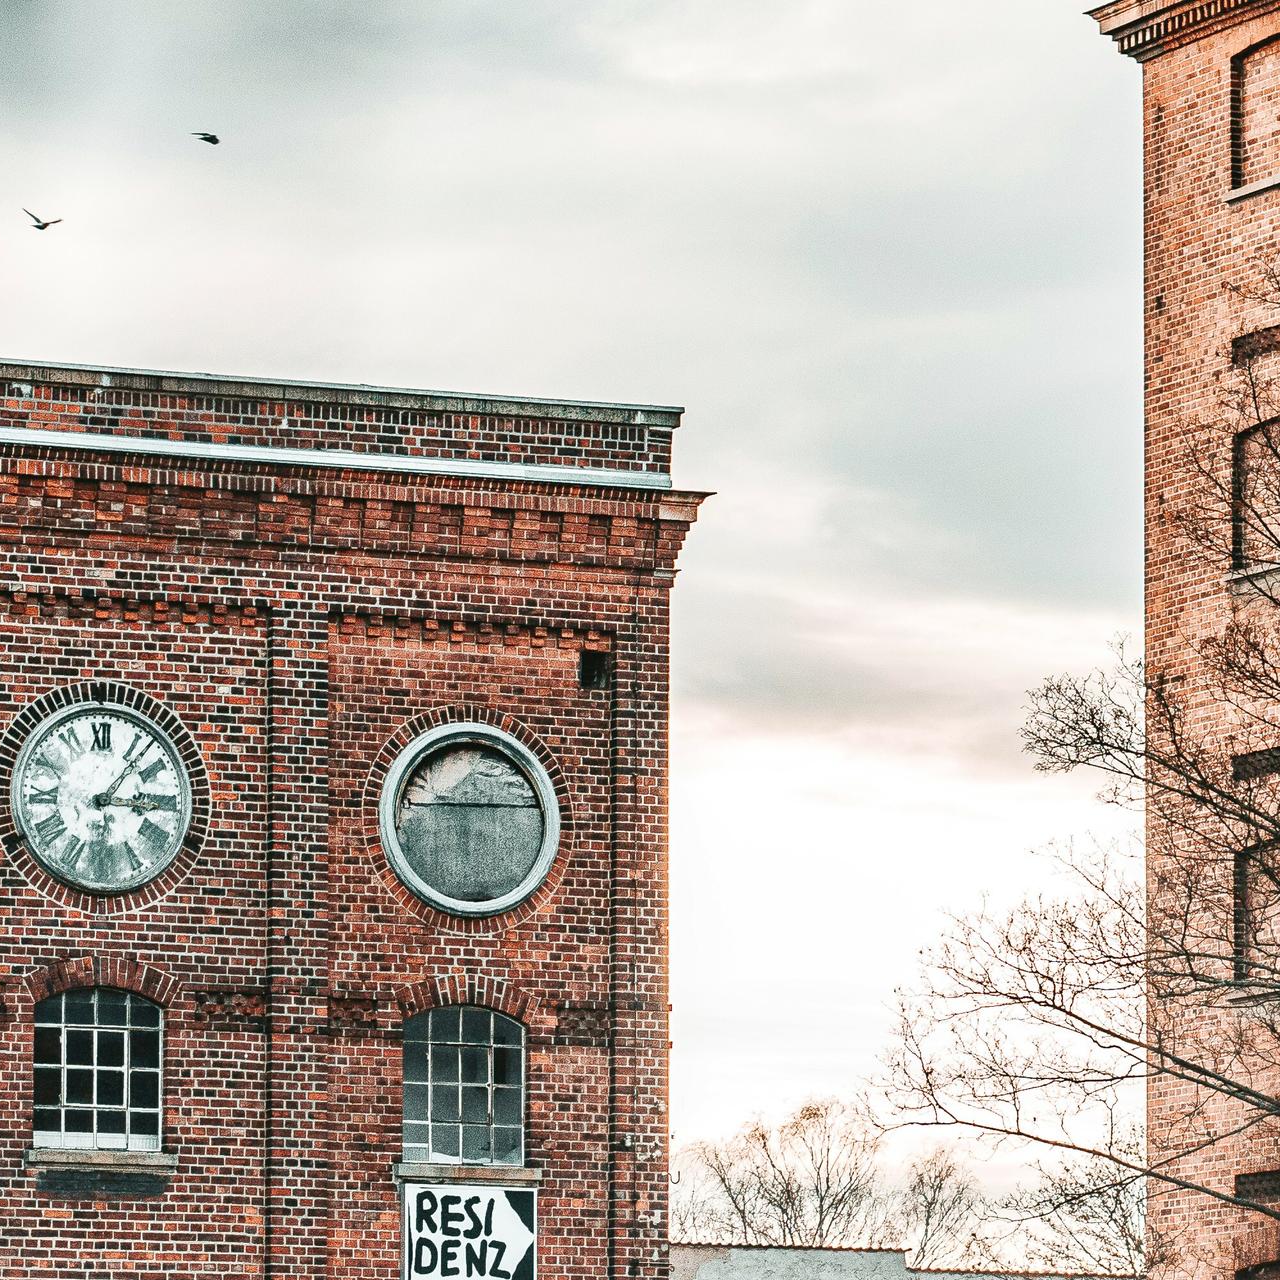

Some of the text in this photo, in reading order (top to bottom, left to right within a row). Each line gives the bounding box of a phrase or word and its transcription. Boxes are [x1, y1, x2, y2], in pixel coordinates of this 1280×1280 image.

[91, 722, 111, 752] XII
[416, 1190, 496, 1239] RESI
[414, 1237, 511, 1280] DENZ
